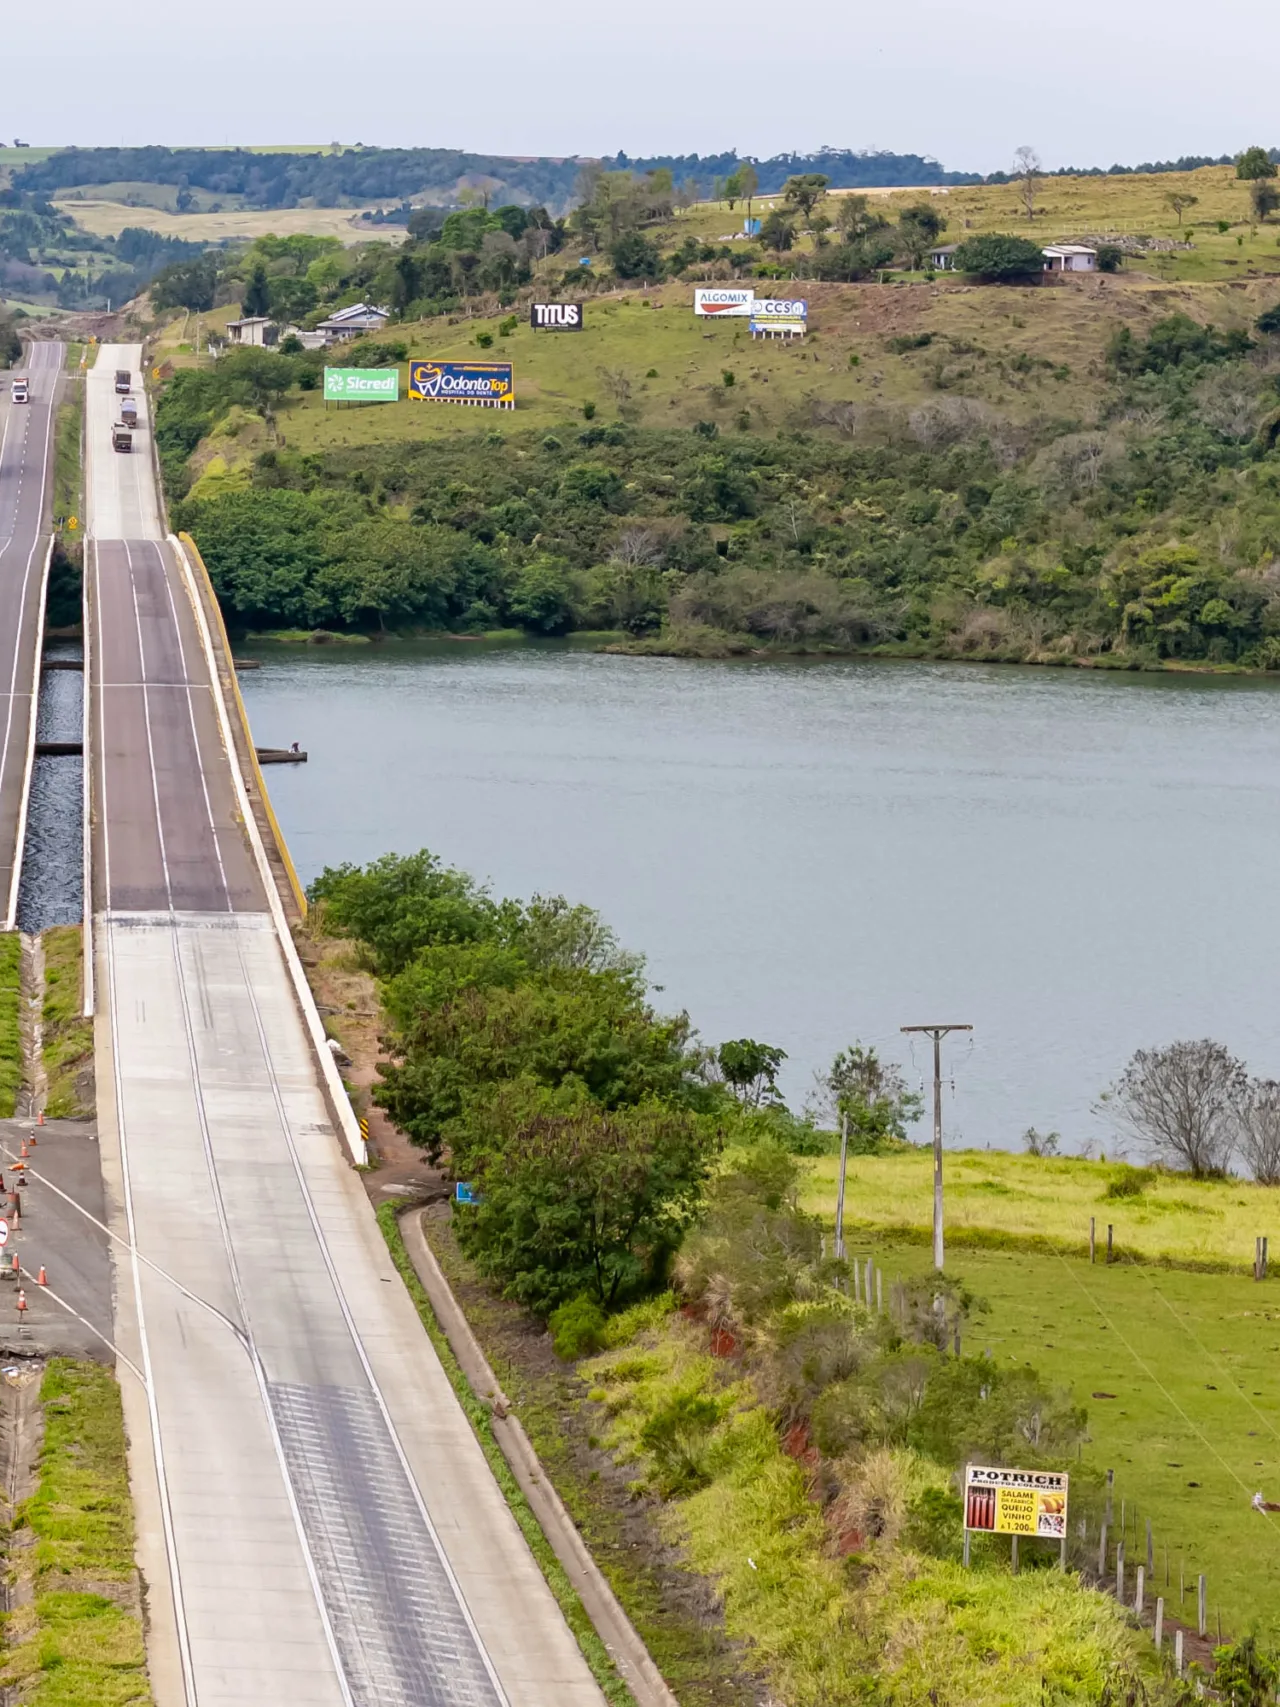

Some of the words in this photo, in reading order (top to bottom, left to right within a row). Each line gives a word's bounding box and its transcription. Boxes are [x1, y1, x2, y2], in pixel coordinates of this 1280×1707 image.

[700, 292, 748, 303] ALGOMIX
[765, 303, 790, 313] CCS
[534, 304, 579, 325] TITUS
[346, 376, 395, 390] Sicredi
[441, 375, 508, 394] OdontoTop
[972, 1470, 1062, 1486] POTRICH
[1001, 1490, 1034, 1499] SALAME
[1001, 1504, 1034, 1513] QUEIJO
[1002, 1512, 1032, 1521] VINHO
